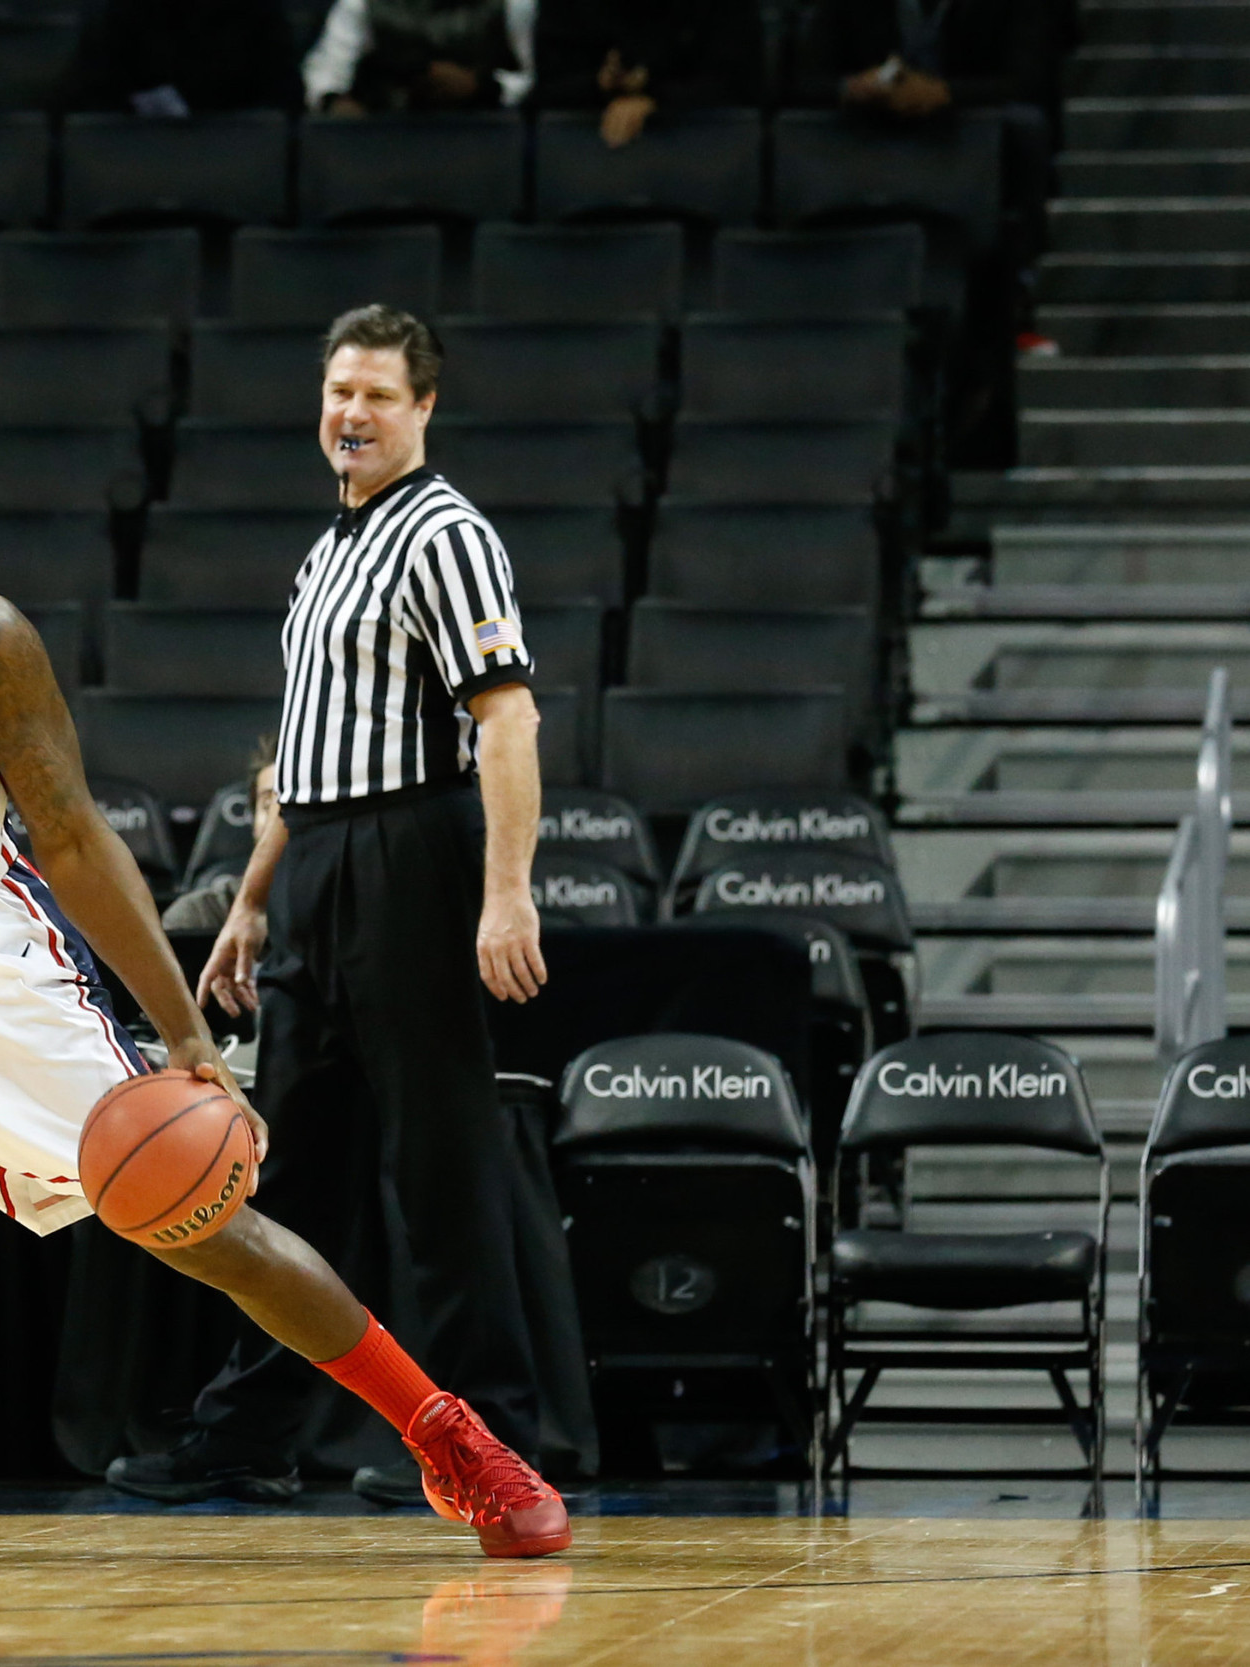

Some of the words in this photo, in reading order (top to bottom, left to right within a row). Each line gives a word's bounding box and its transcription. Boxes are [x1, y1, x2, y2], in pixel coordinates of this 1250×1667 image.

[560, 807, 632, 840] Klein
[706, 808, 799, 842] Calvin
[800, 807, 870, 839] Klein
[546, 875, 618, 907] Klein
[716, 871, 810, 905] Calvin
[811, 872, 885, 905] Klein
[583, 1063, 688, 1099] Calvin
[692, 1064, 771, 1100] Klein
[877, 1061, 982, 1098] Calvin
[987, 1063, 1067, 1098] Klein
[150, 1161, 244, 1243] Wilson
